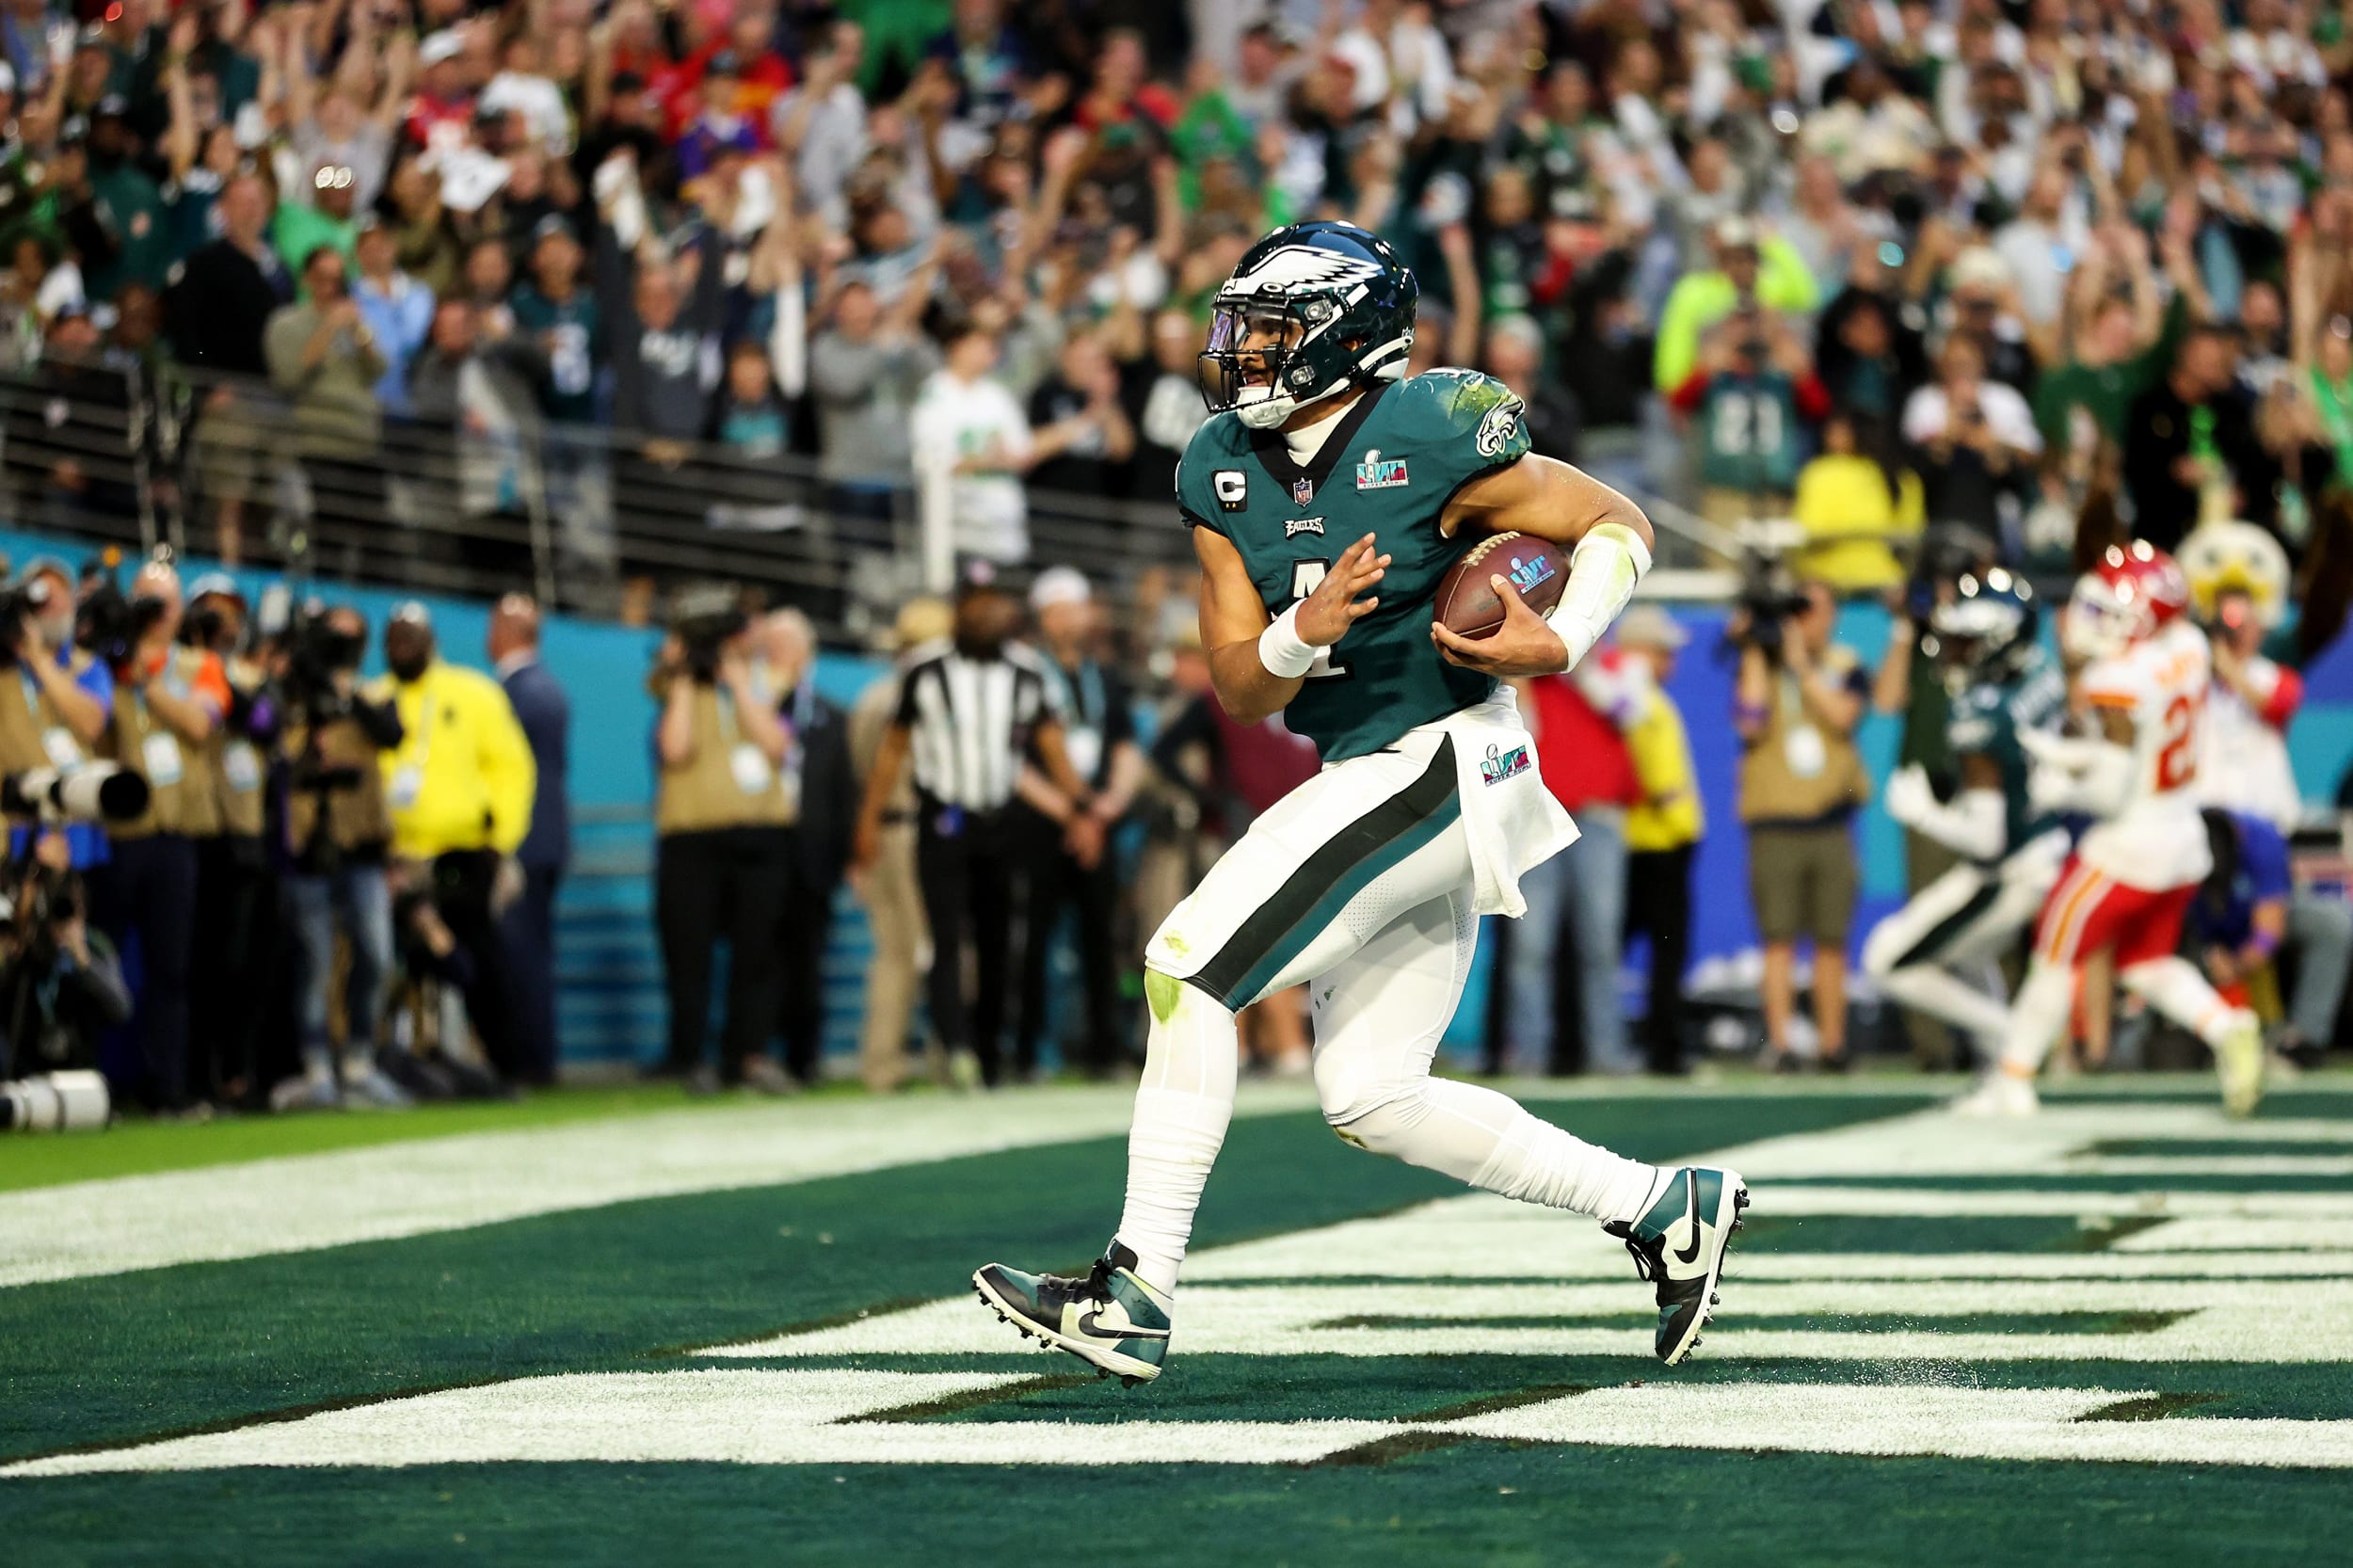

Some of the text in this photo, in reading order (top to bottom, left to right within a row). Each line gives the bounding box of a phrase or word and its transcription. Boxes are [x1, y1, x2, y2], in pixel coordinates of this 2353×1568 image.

[1215, 472, 1246, 502] C
[1297, 490, 1311, 502] NFL
[1285, 517, 1325, 537] EAGLES
[1487, 772, 1510, 785] SUPER
